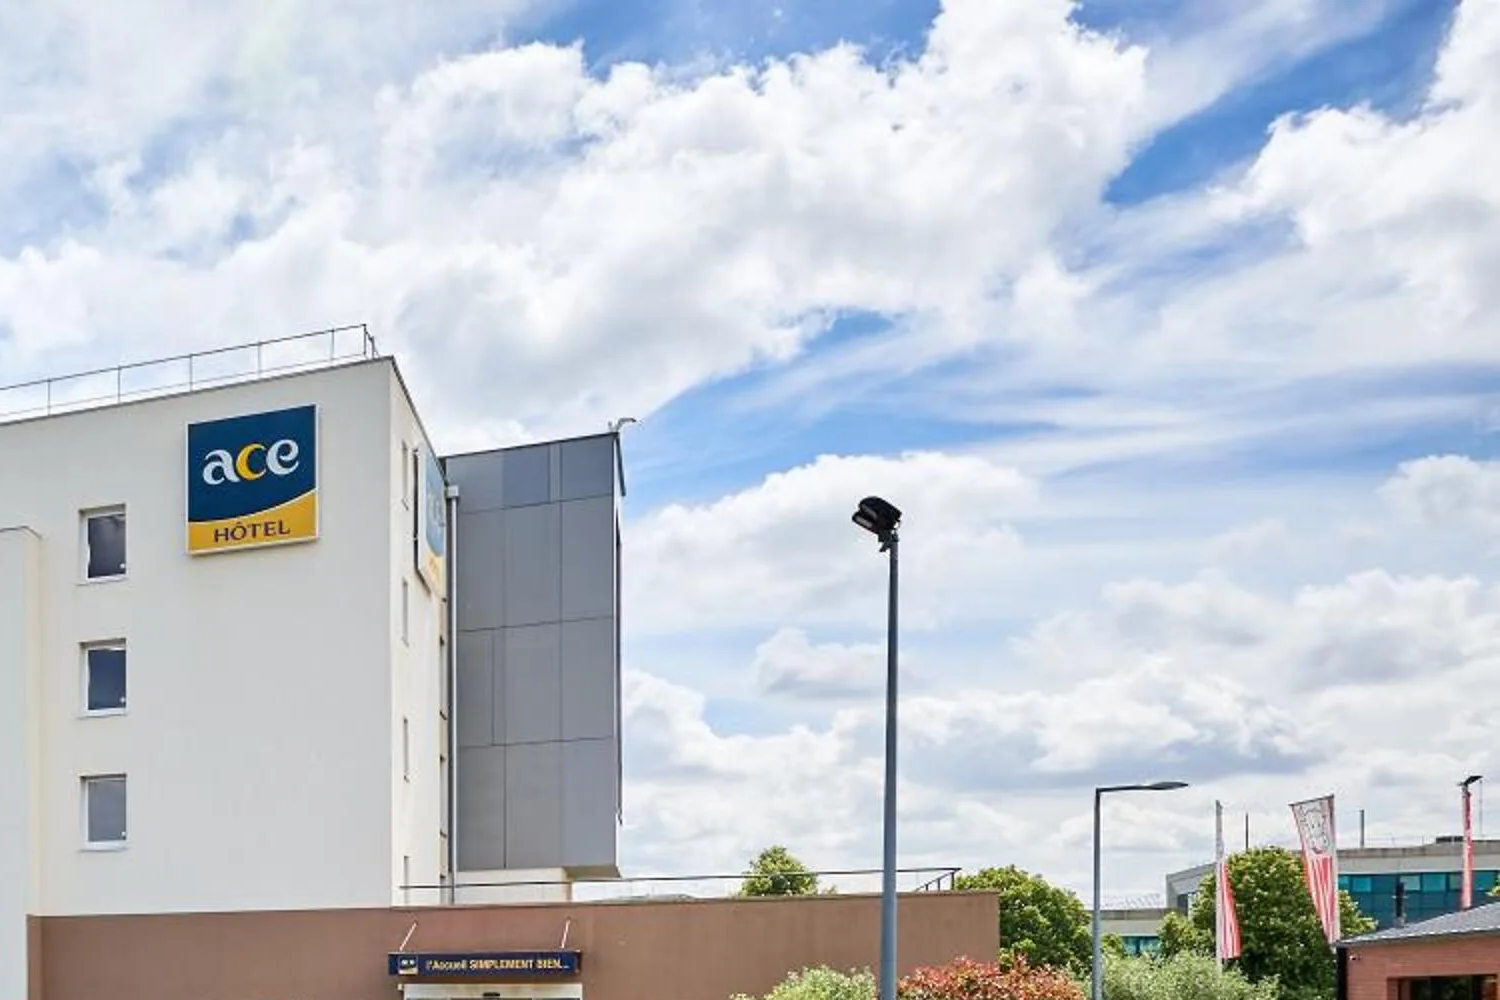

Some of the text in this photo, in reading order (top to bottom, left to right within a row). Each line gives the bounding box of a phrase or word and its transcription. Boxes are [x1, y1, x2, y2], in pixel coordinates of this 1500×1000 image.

[202, 438, 300, 485] ace
[213, 519, 291, 543] HÔTEL
[469, 959, 533, 970] SIMPLEMENT
